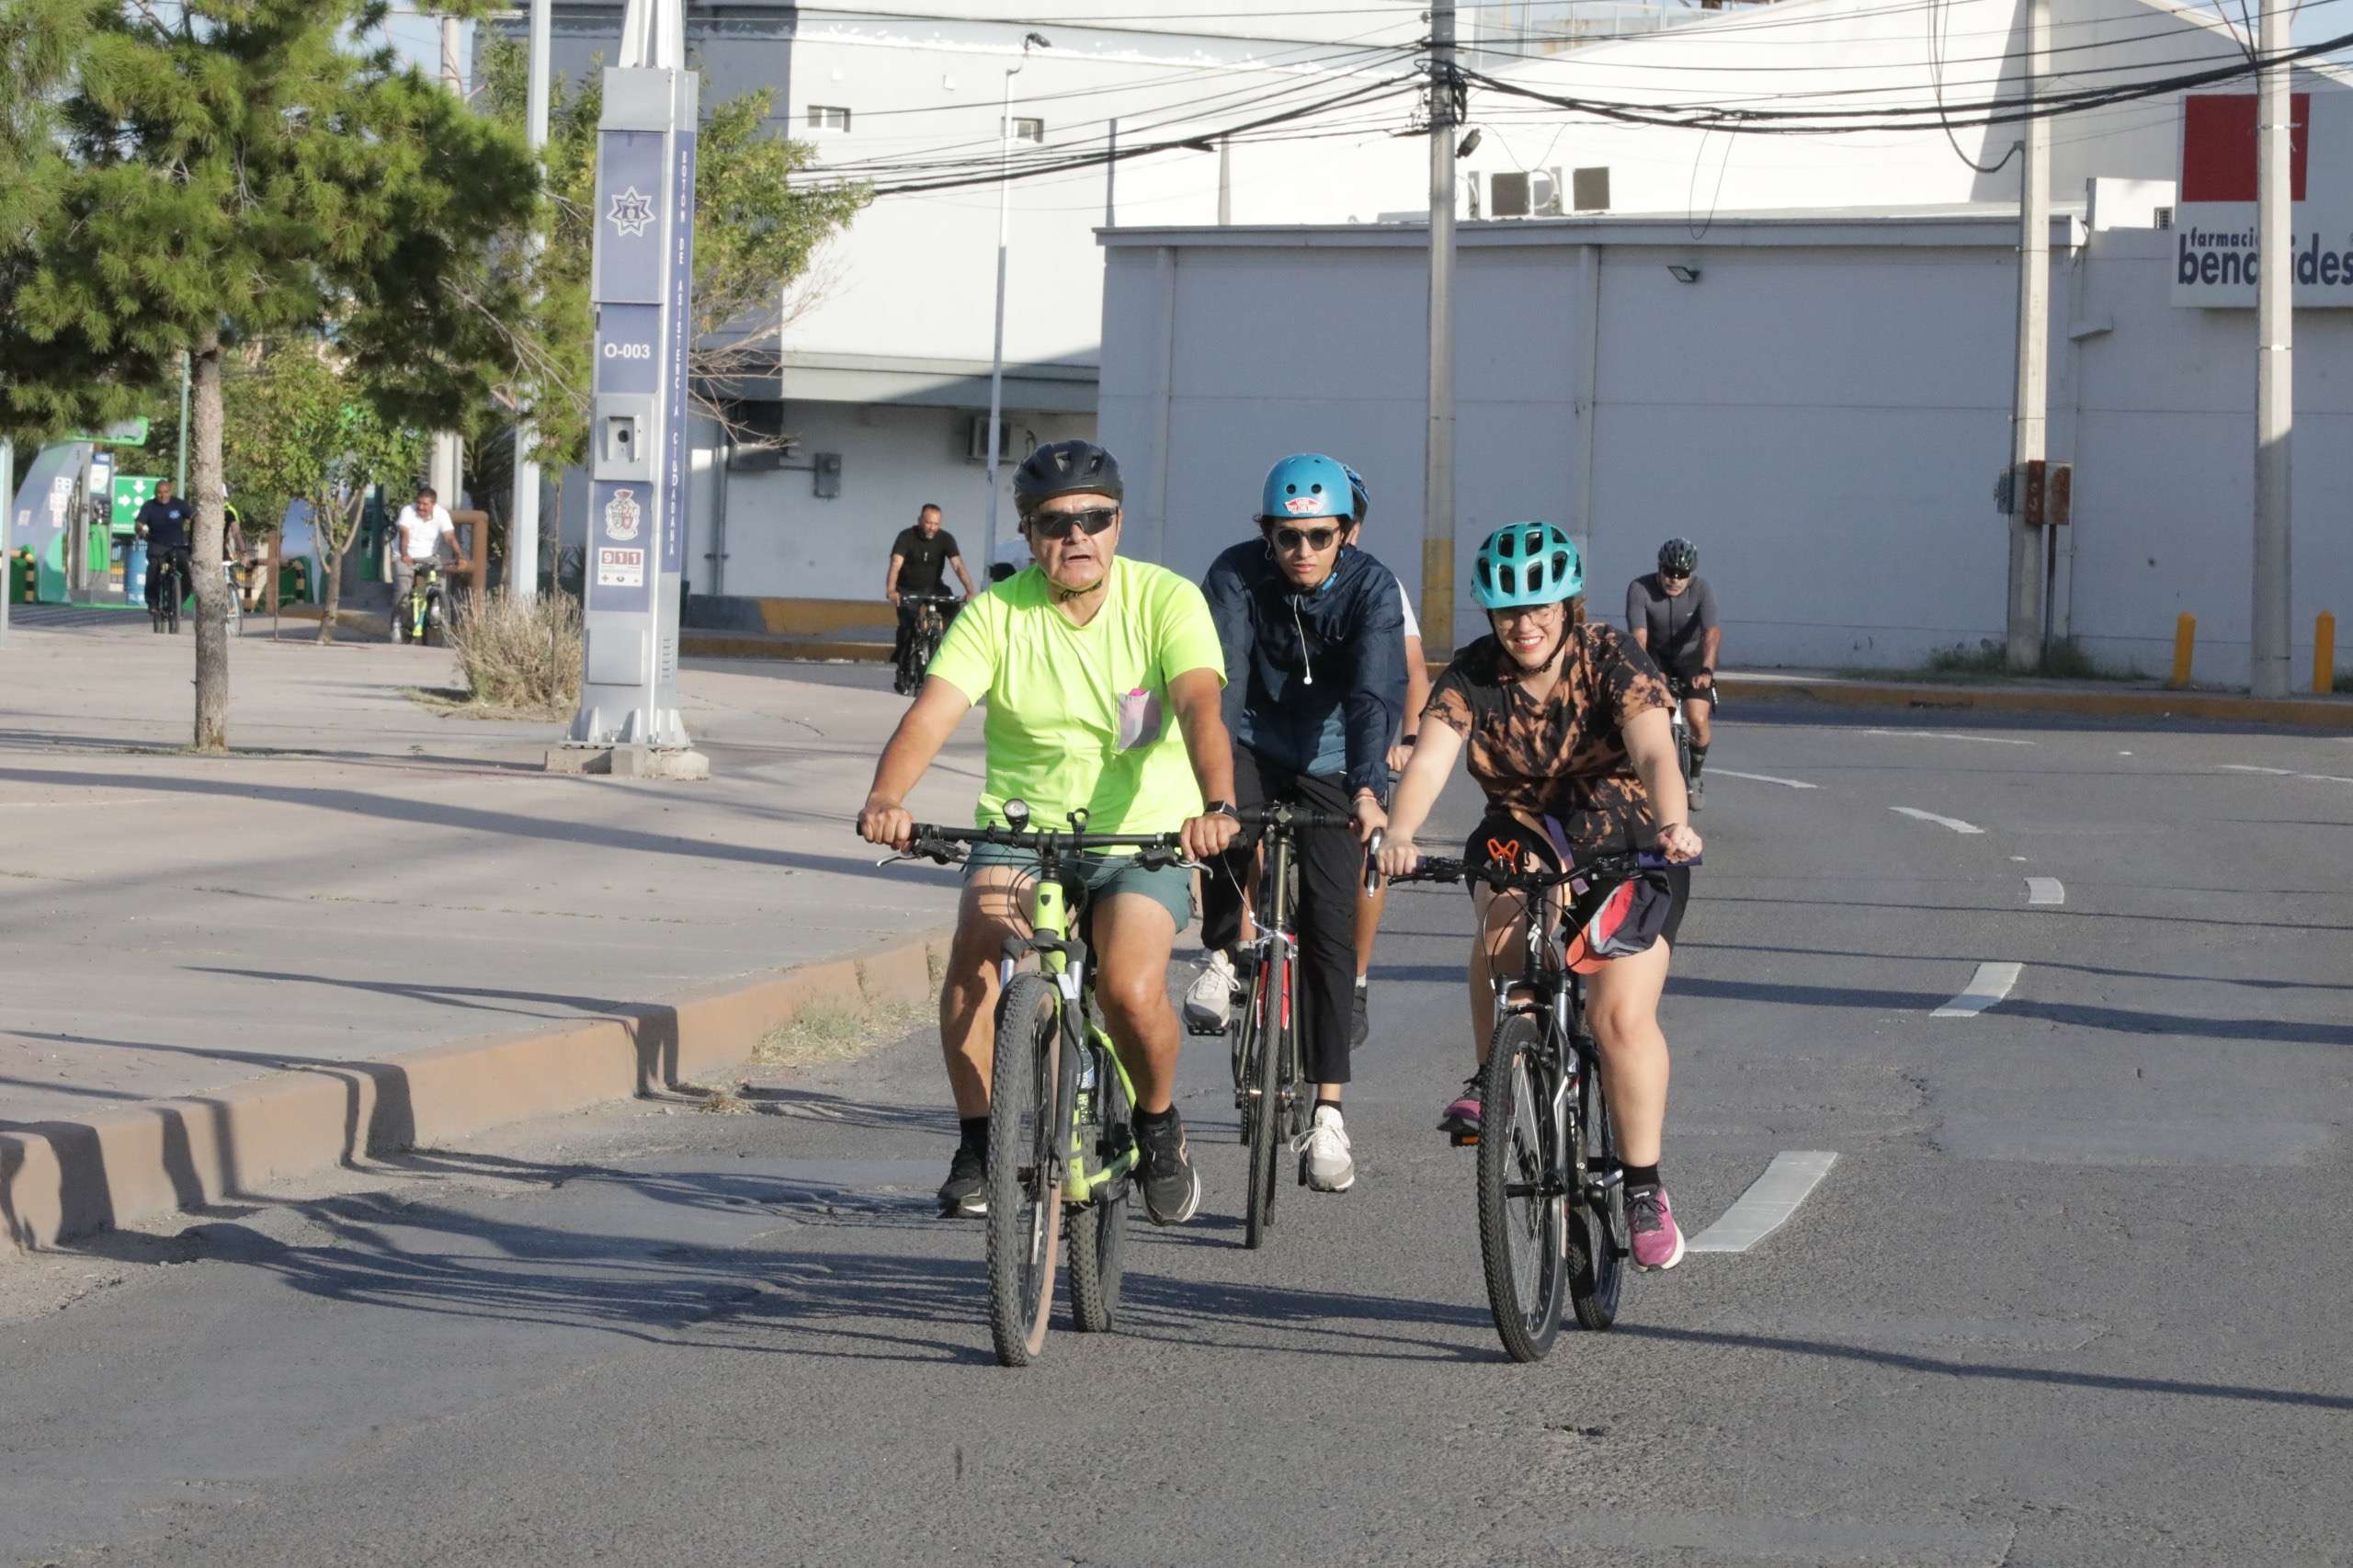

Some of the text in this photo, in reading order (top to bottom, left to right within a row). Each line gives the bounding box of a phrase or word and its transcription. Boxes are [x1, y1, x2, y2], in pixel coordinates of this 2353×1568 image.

[2190, 226, 2259, 247] farmaci
[678, 237, 685, 265] DE
[2177, 233, 2353, 286] benaides
[603, 551, 638, 564] 911
